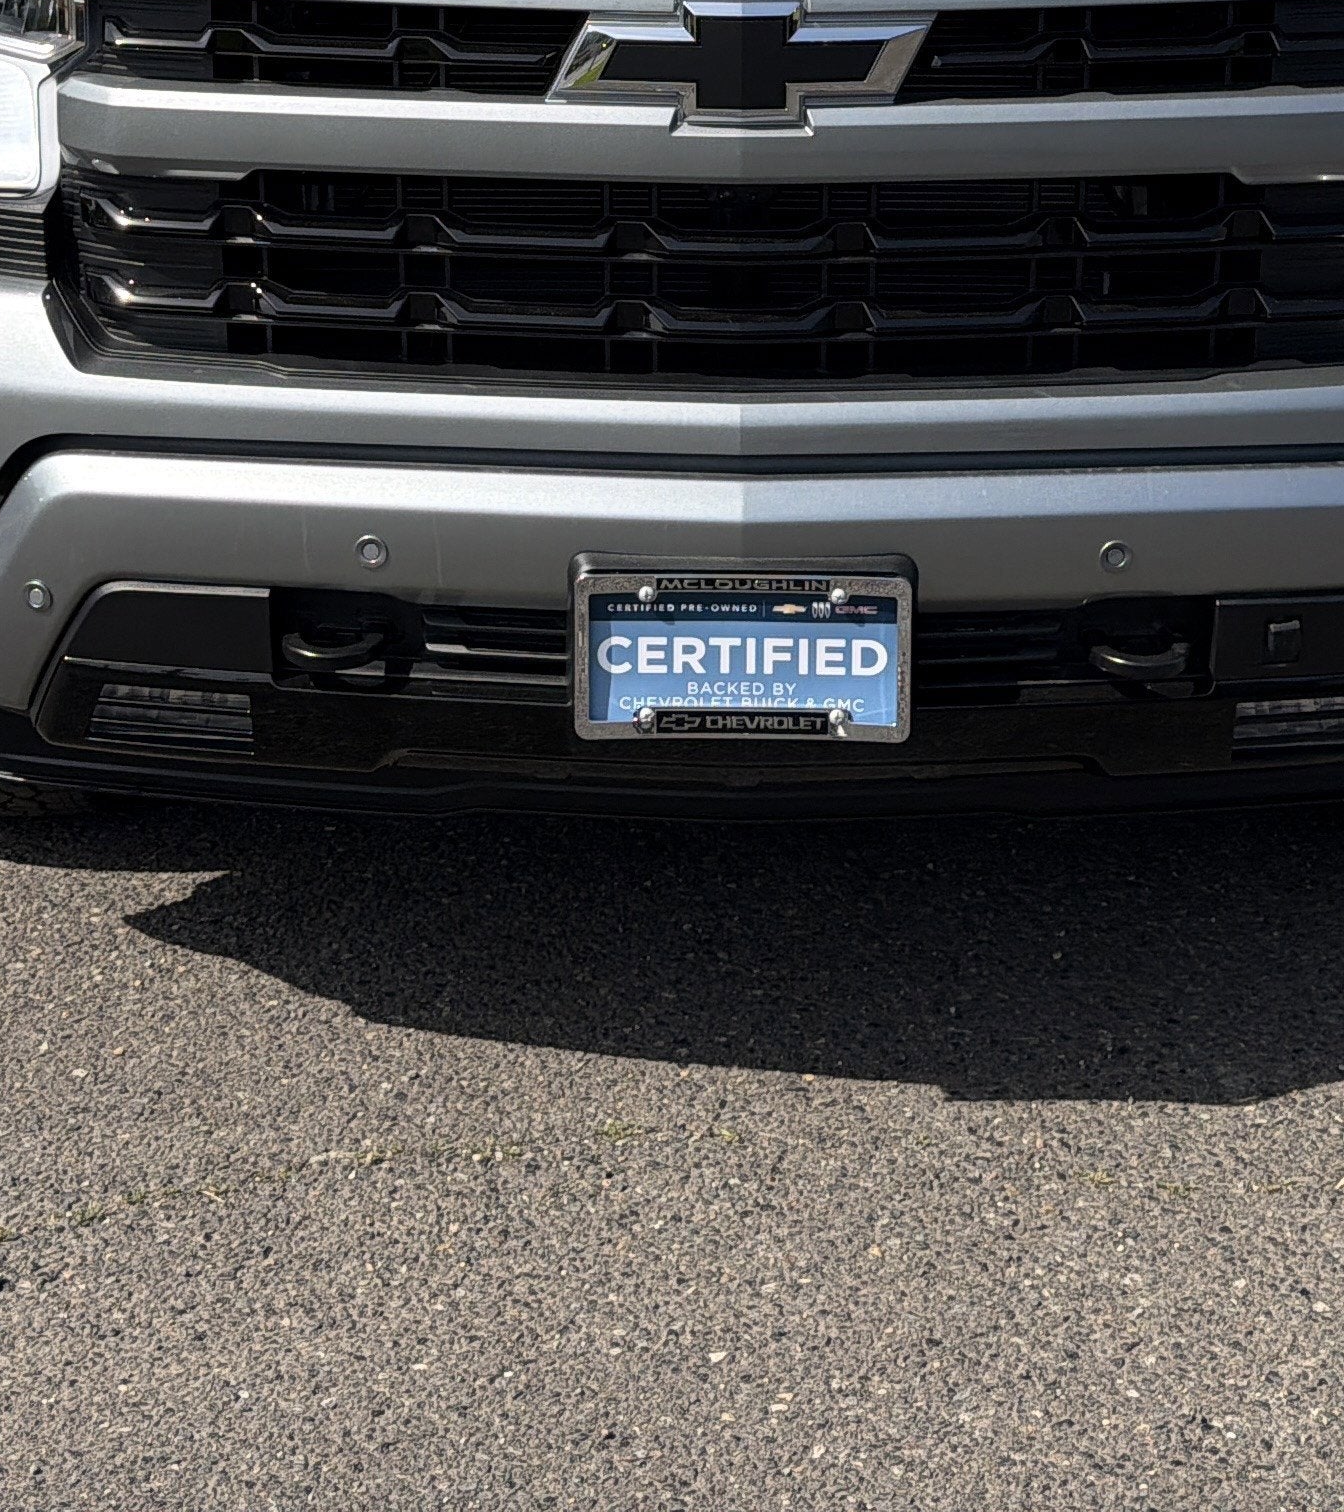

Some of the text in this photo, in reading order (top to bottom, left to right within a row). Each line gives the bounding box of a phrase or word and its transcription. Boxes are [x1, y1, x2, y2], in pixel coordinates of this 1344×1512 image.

[607, 603, 878, 615] CERTIFIED PRE-OWNED GMC
[597, 635, 889, 677] CERTIFIED
[687, 681, 797, 696] BACKED BY
[805, 697, 817, 708] &
[823, 698, 865, 713] GMC
[705, 715, 827, 731] CHEVROLET
